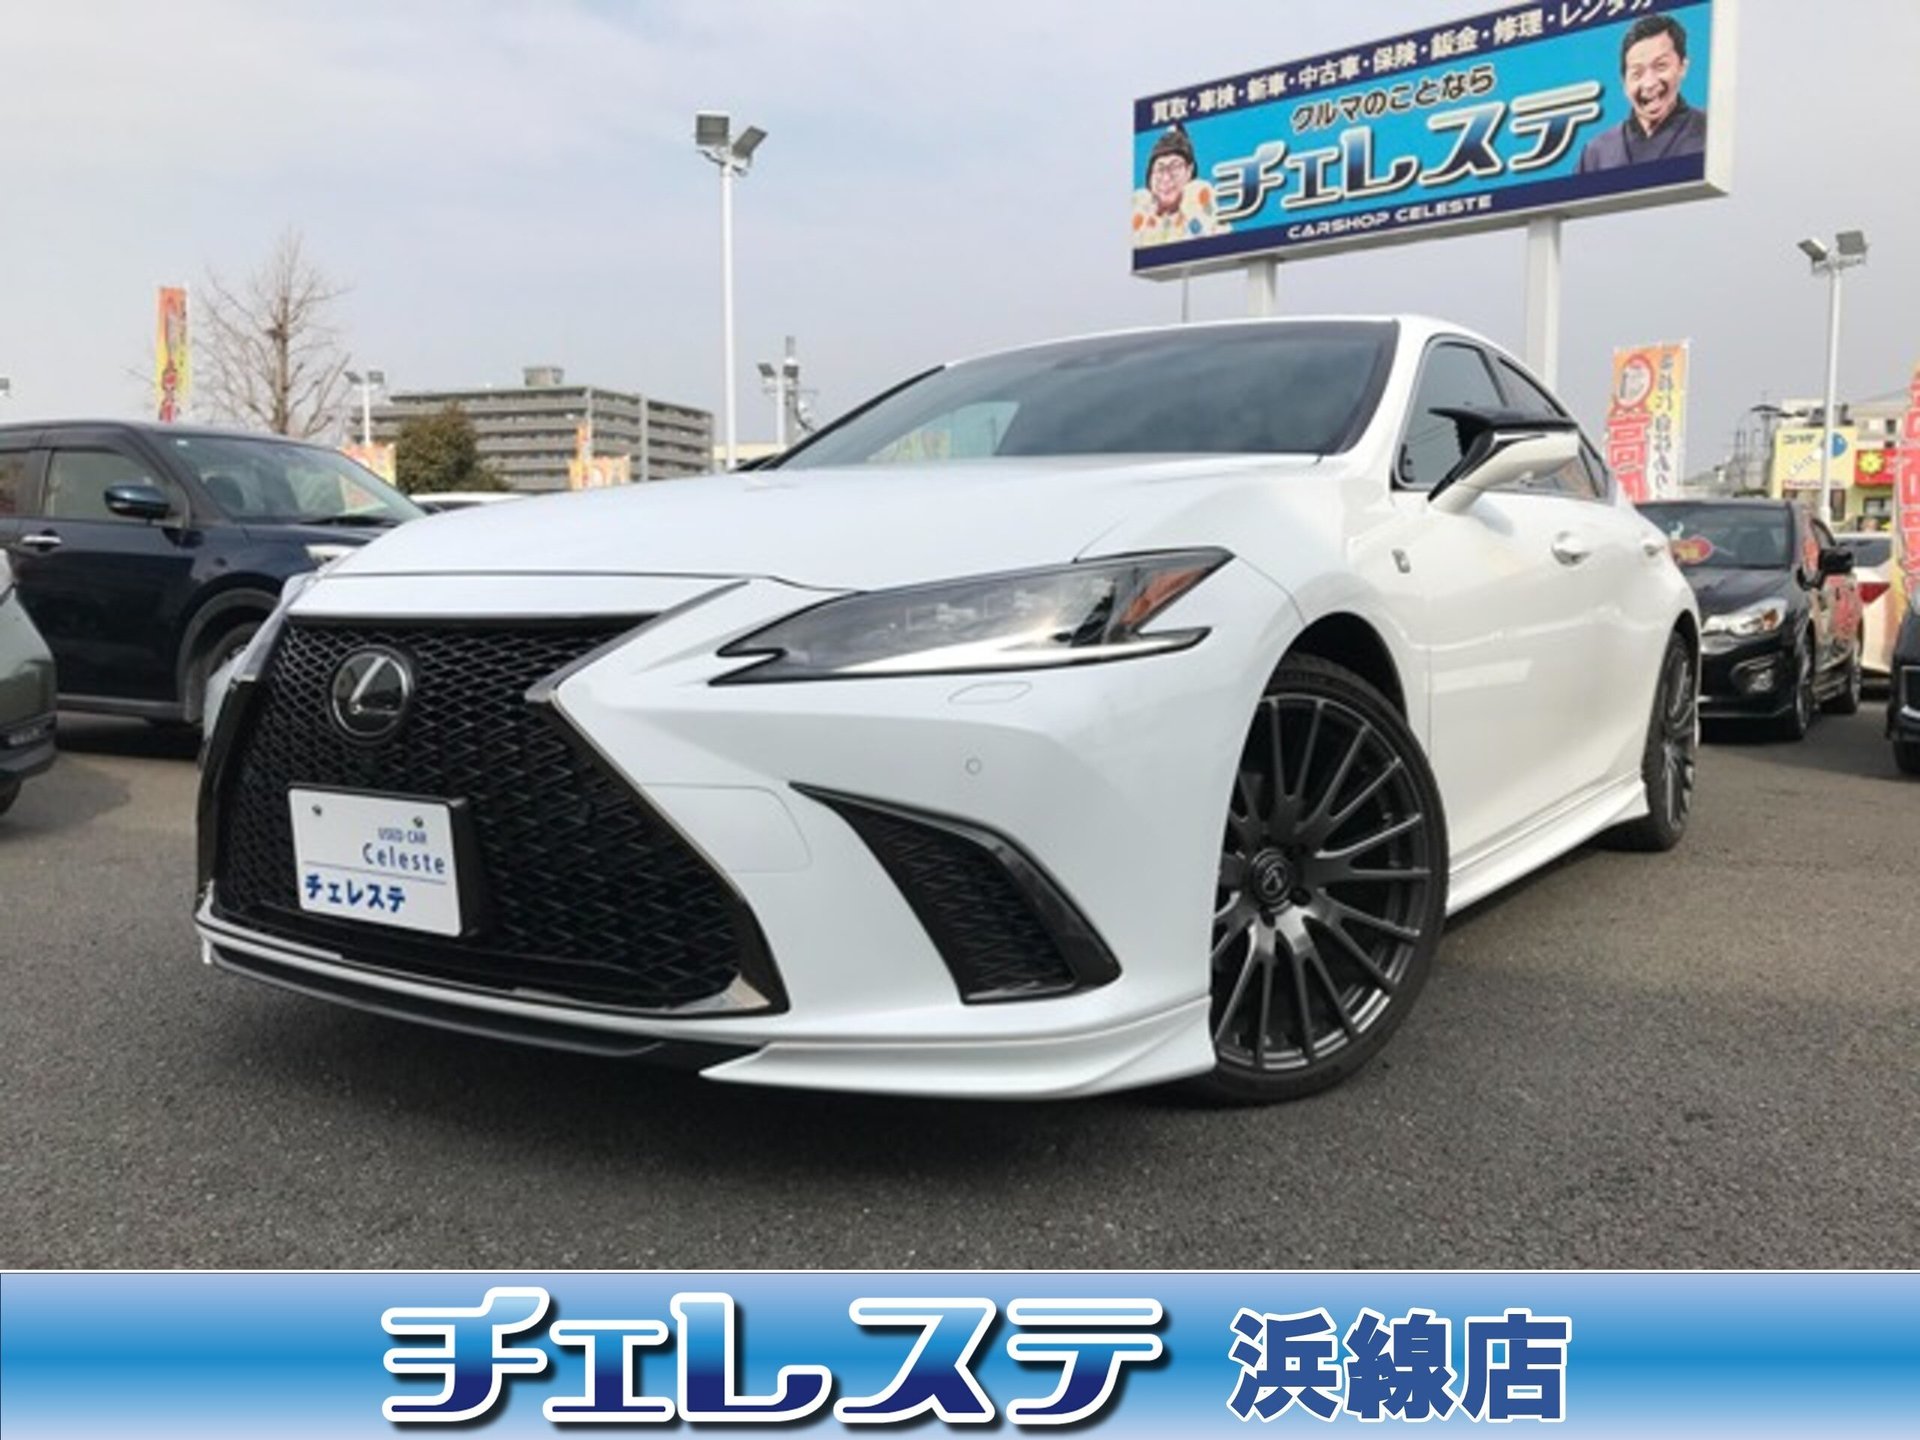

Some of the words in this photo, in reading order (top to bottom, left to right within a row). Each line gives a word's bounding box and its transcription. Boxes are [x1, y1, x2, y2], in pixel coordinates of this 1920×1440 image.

[1291, 62, 1495, 133] クルマのことなら
[1210, 80, 1602, 221] チェレステ
[1286, 214, 1390, 240] CARSHOP
[1394, 195, 1493, 221] CELESTE
[362, 842, 446, 875] Celeste
[305, 873, 406, 913] チェレステ
